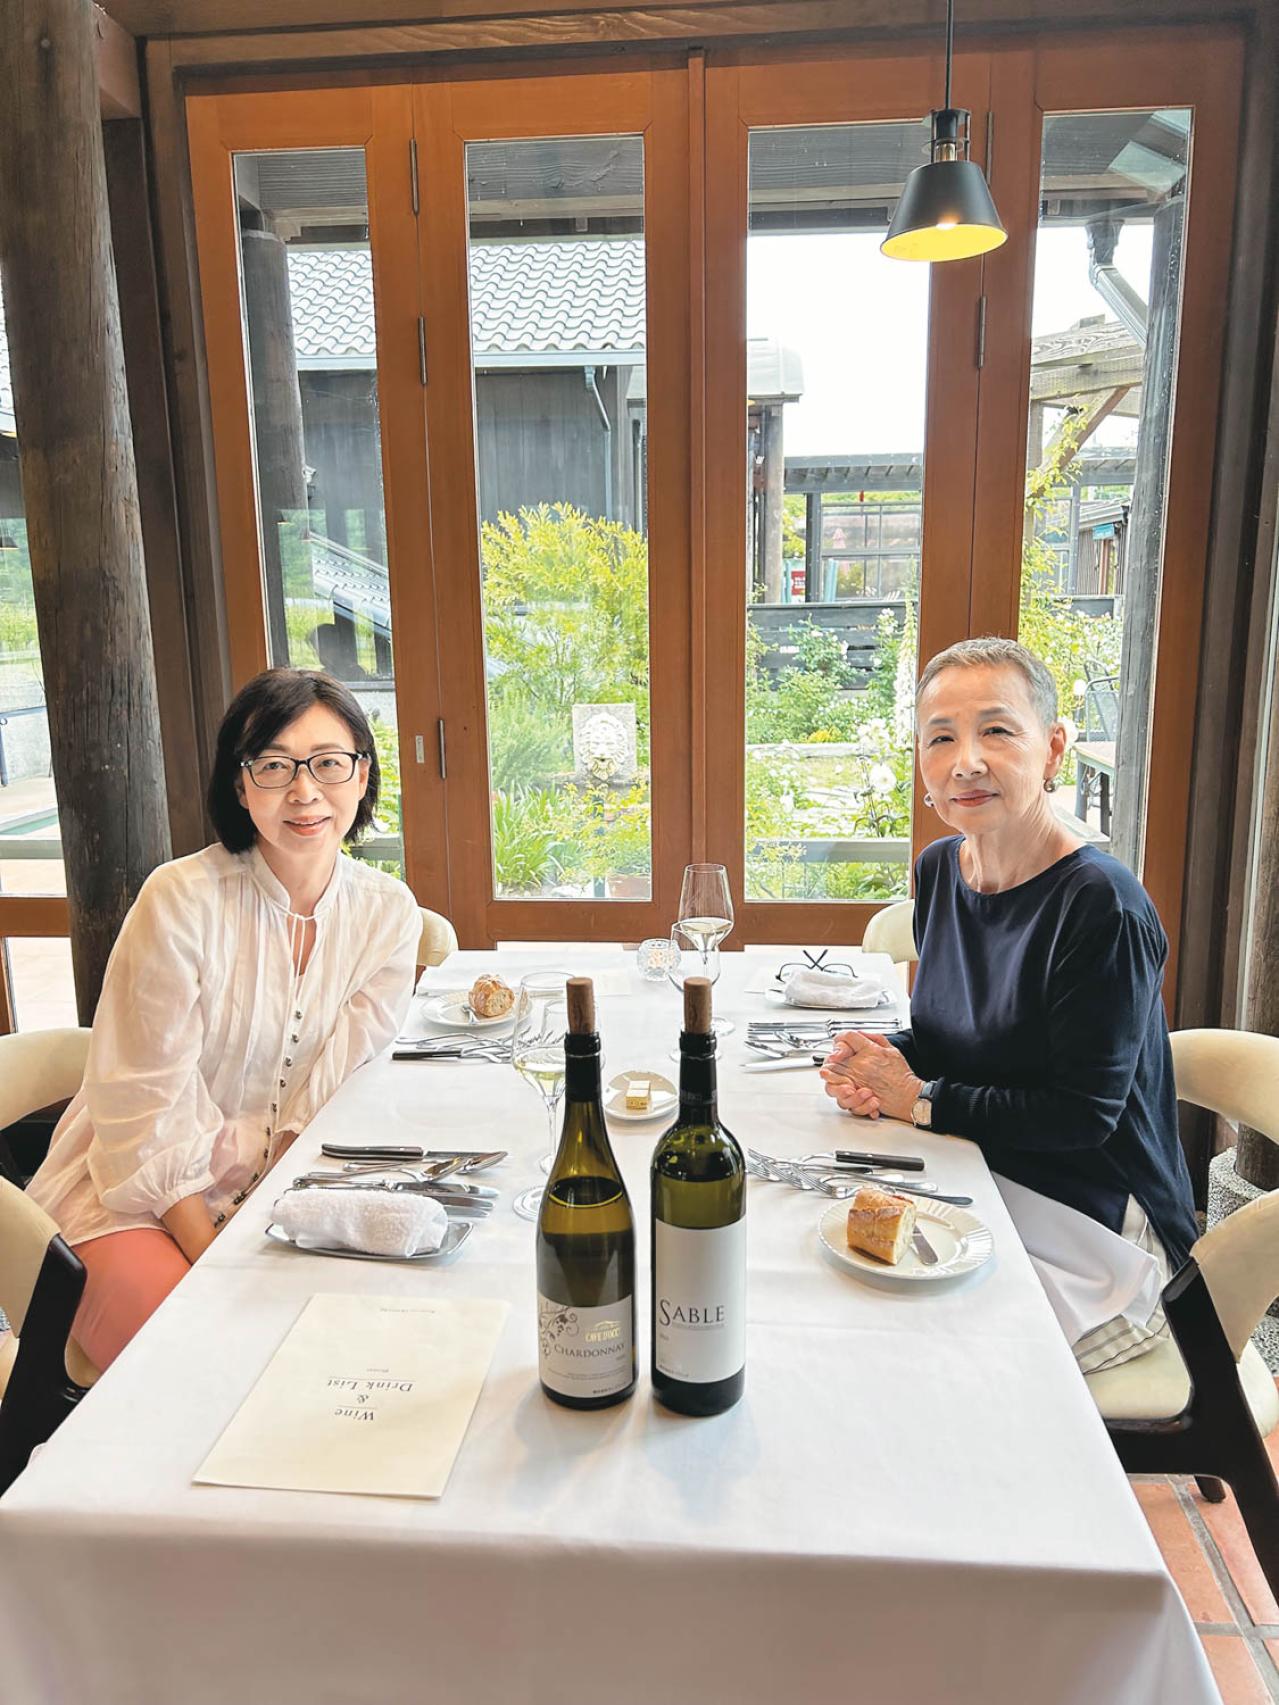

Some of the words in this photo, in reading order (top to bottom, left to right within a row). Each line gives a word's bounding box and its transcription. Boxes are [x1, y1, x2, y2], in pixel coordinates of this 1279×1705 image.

[658, 1298, 724, 1326] SABLE
[554, 1343, 625, 1357] CHARDONNAY
[327, 1379, 358, 1391] List
[366, 1381, 413, 1392] Drink
[357, 1394, 369, 1404] &
[334, 1408, 374, 1421] Wine
